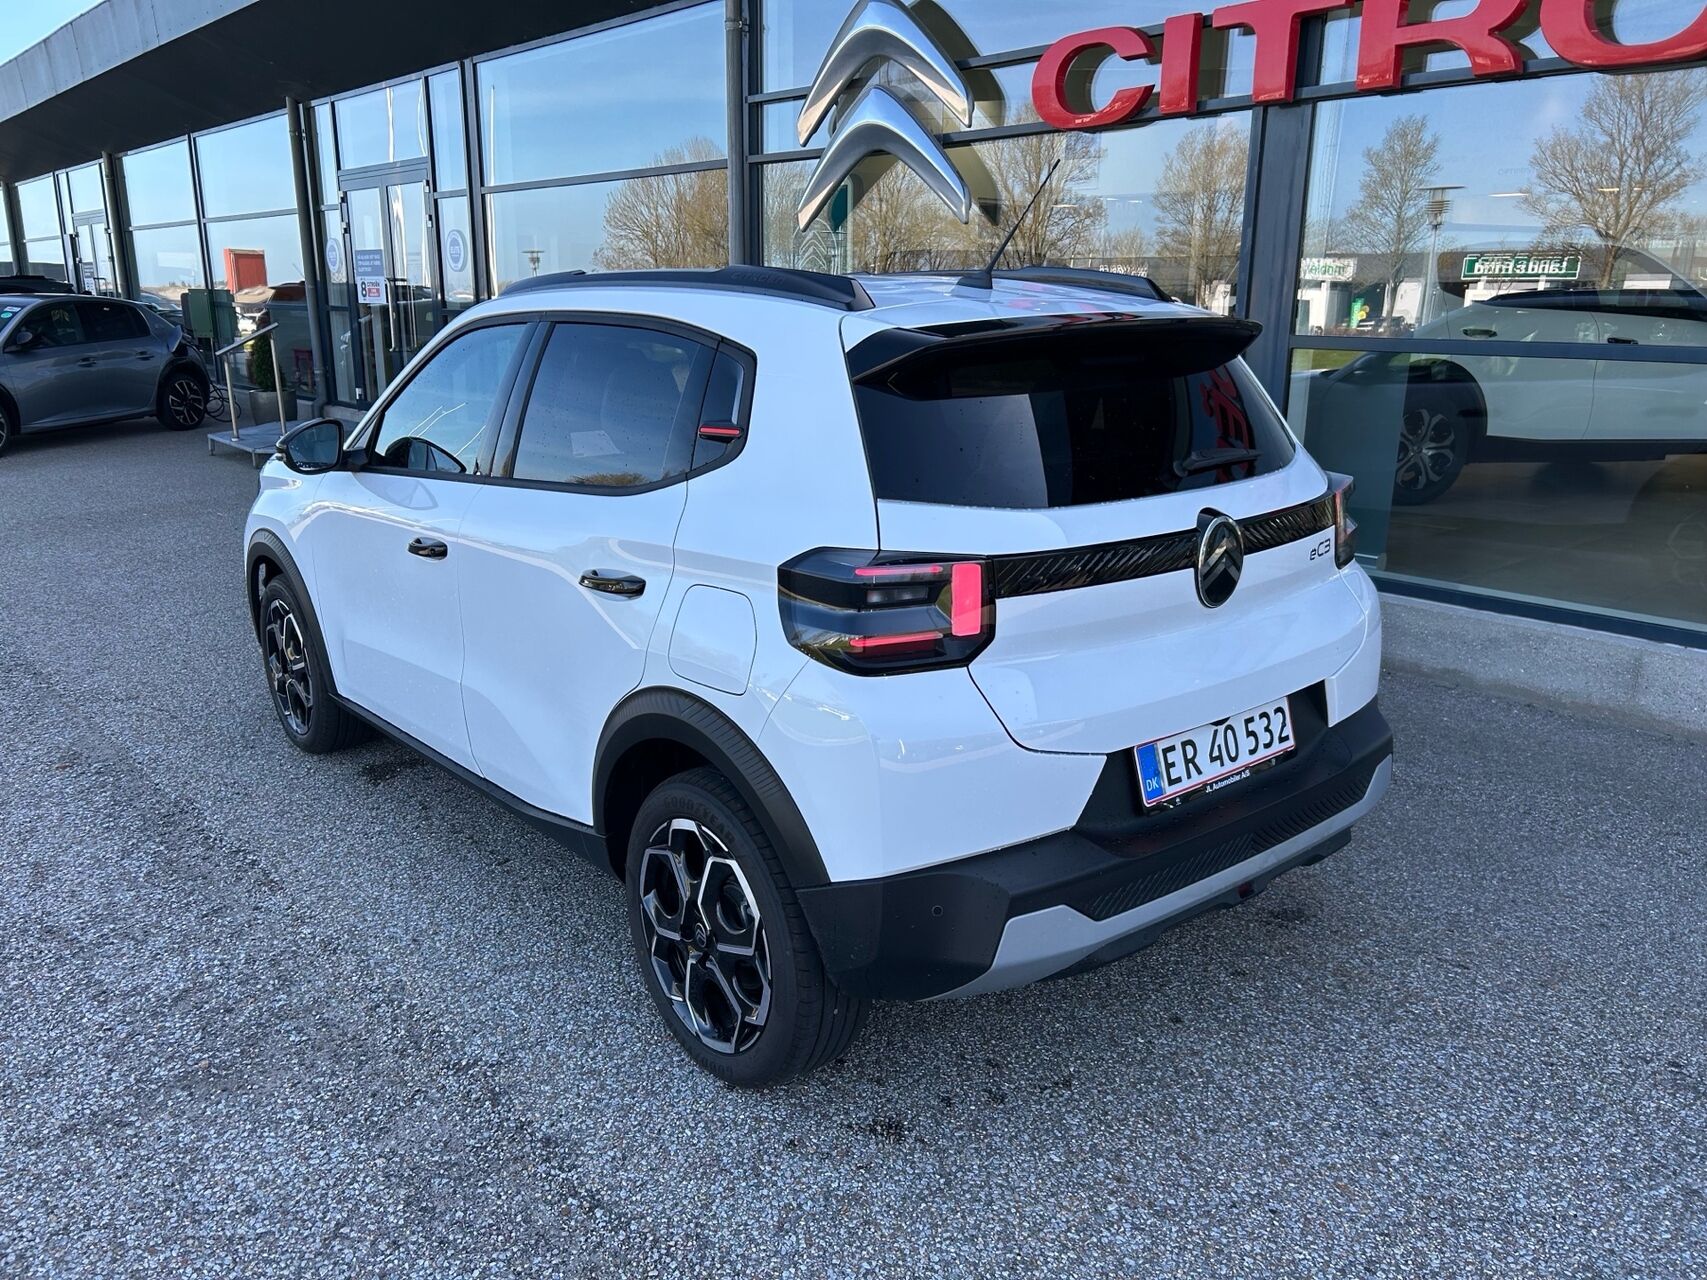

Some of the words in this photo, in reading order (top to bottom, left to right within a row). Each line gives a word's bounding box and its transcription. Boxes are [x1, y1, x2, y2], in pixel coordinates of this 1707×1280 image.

[1309, 537, 1331, 561] eC3
[1161, 738, 1203, 787] ER
[1208, 723, 1240, 768] 40
[1244, 706, 1290, 756] 532
[1145, 777, 1160, 792] DK
